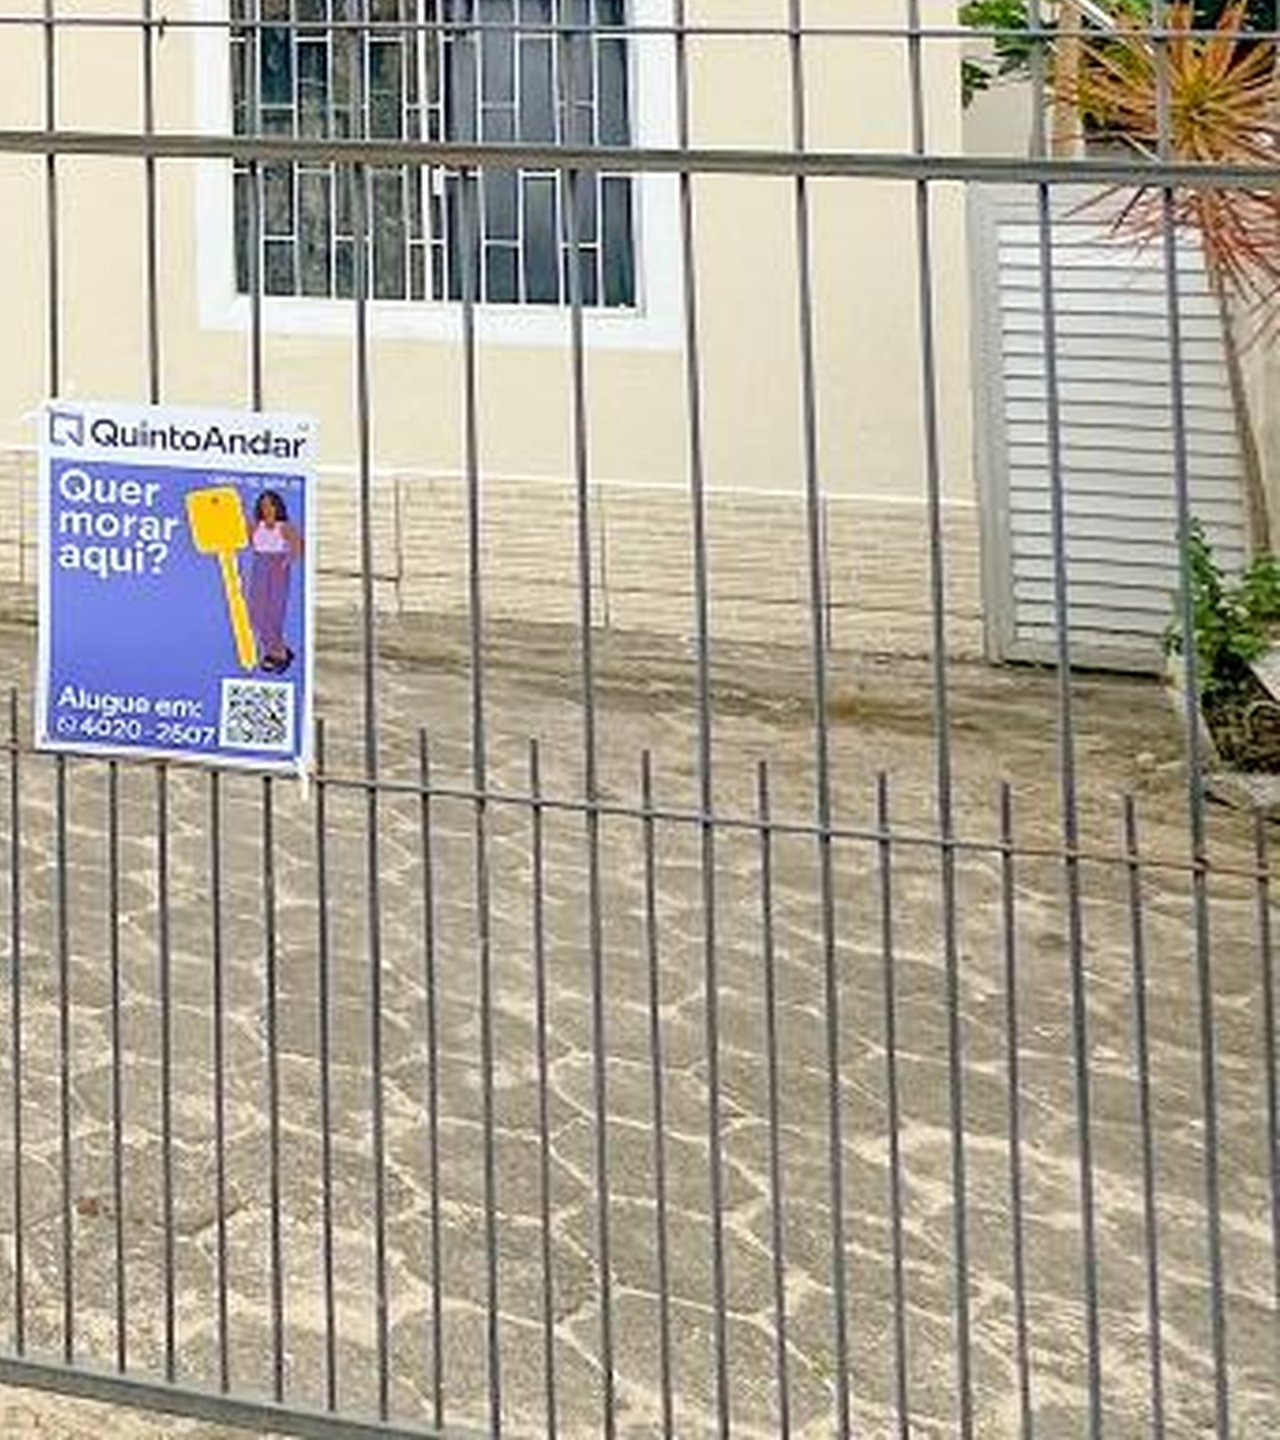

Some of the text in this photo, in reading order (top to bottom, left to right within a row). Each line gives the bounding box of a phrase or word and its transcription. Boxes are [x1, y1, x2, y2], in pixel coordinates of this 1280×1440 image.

[90, 419, 306, 459] QuintoAndar
[59, 468, 161, 507] Quer
[59, 511, 179, 541] morar
[59, 540, 169, 579] aqui?
[57, 685, 150, 718] Alugue
